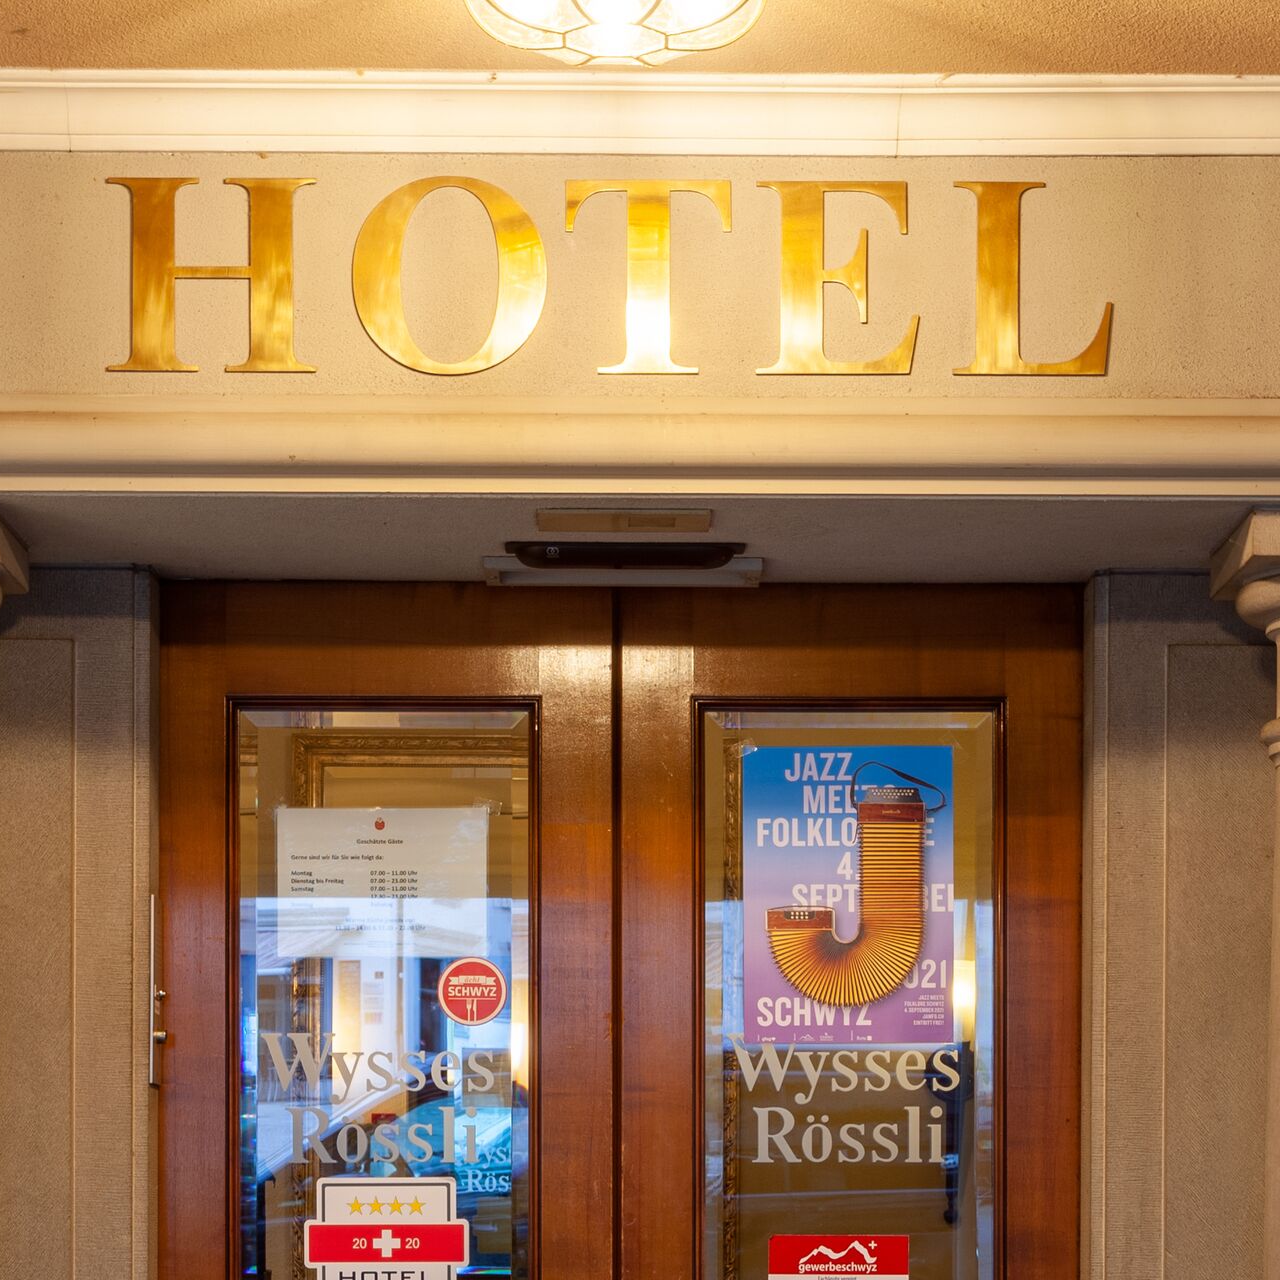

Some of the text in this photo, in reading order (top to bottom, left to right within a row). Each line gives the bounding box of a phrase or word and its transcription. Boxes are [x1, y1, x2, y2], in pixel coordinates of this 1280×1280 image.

[105, 175, 1114, 376] HOTEL
[785, 752, 853, 782] JAZZ
[756, 817, 935, 848] FOLKLOE
[448, 986, 496, 997] SCHWYZ
[260, 1032, 495, 1104] Wysses
[727, 1033, 960, 1104] Wysses
[286, 1106, 481, 1164] Rössli
[752, 1105, 945, 1164] Rössli
[352, 1238, 420, 1250] 20 20
[798, 1261, 877, 1274] gewerbeschwyz
